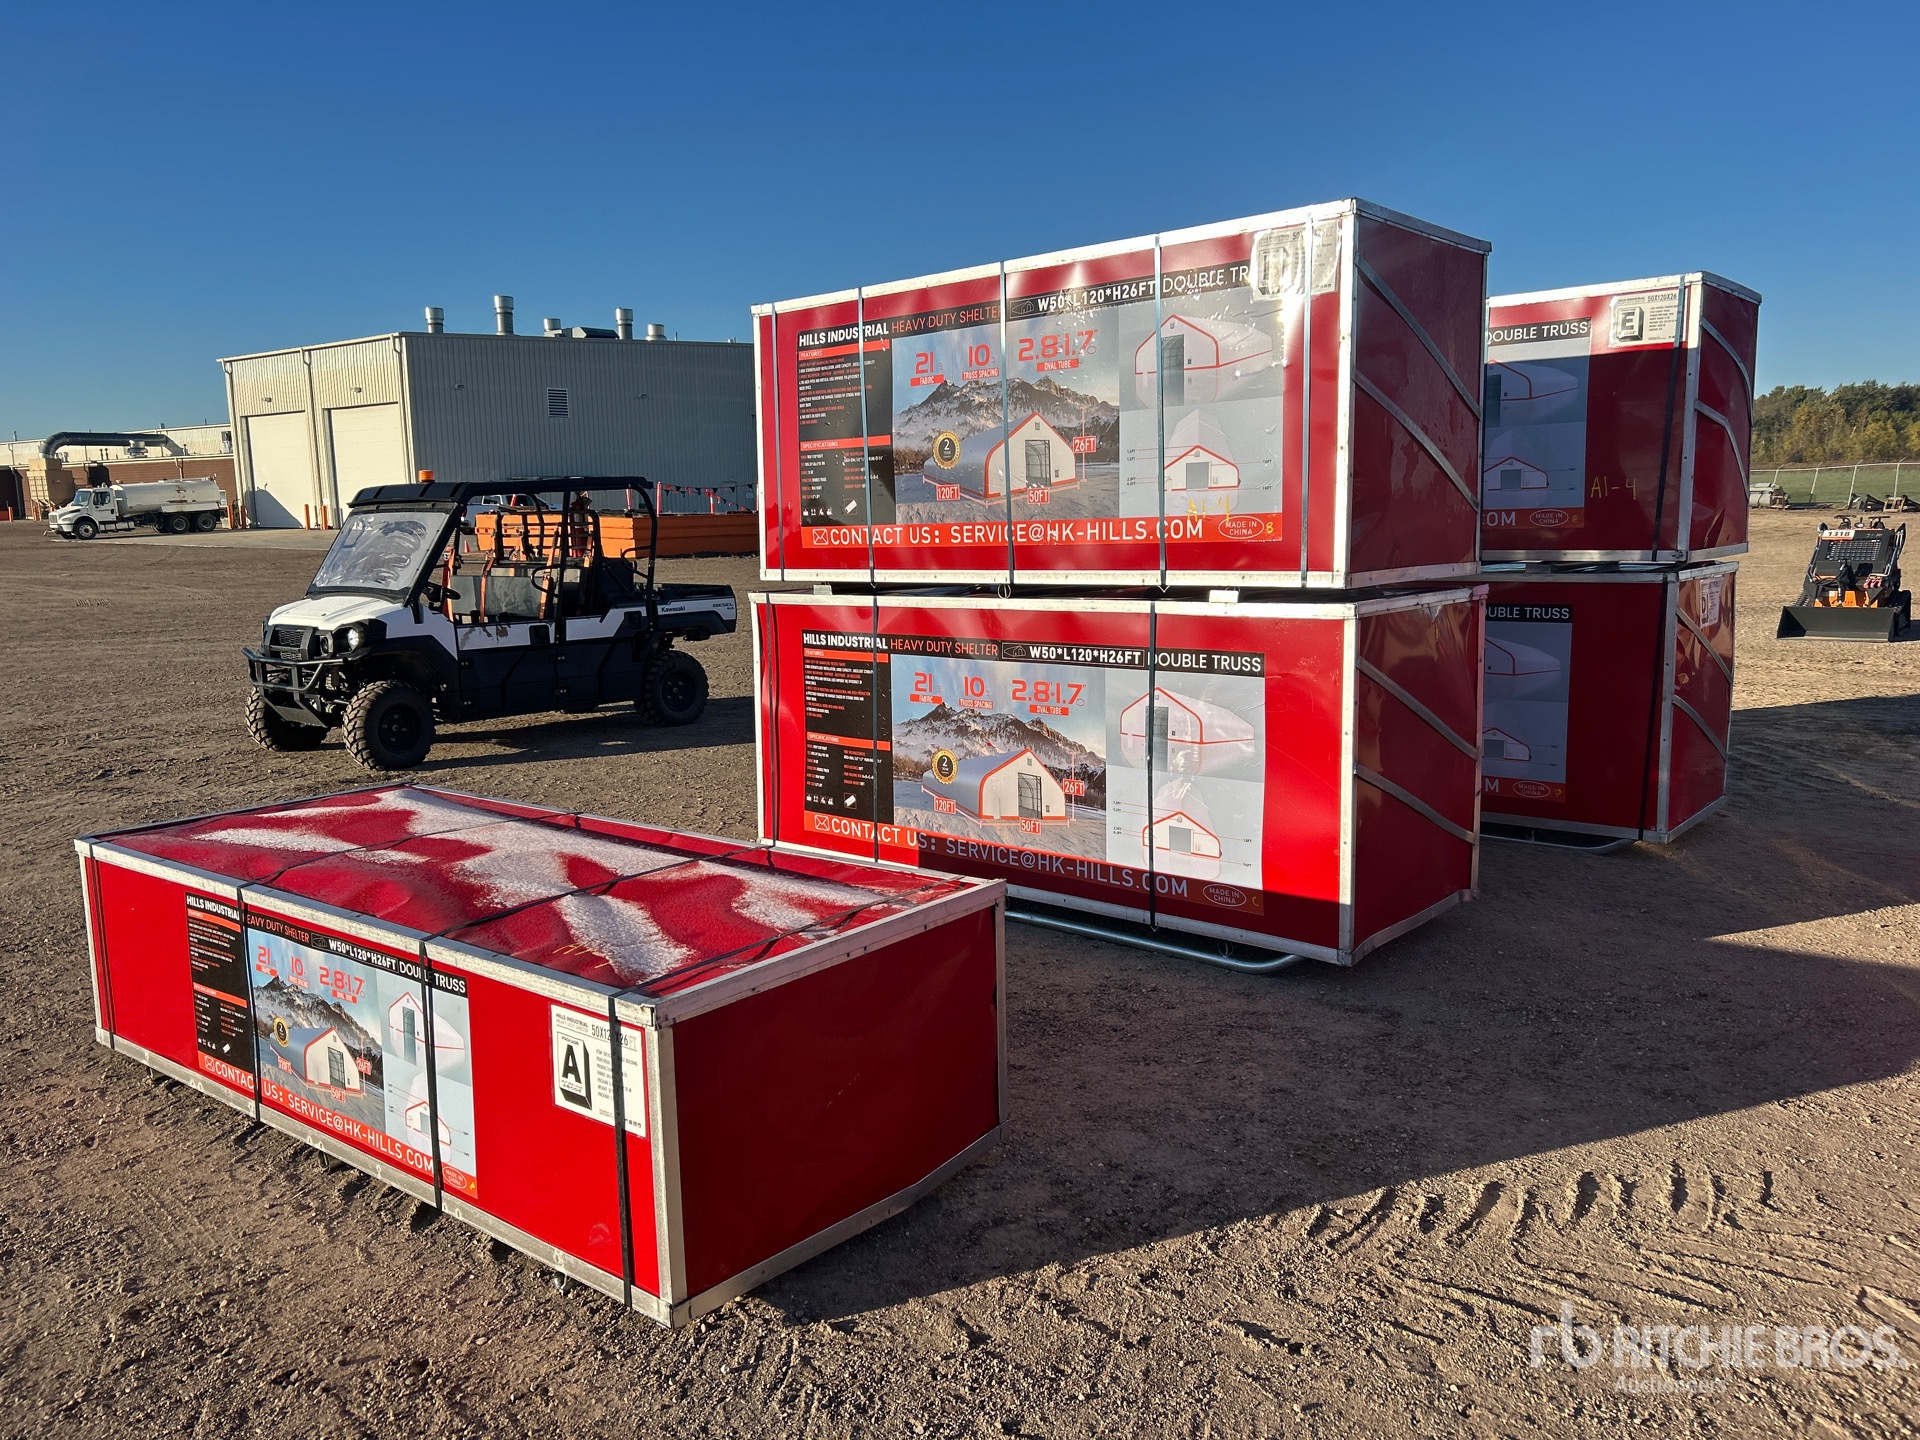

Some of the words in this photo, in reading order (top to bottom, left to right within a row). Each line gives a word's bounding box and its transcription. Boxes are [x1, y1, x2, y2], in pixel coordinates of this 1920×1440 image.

[799, 332, 826, 347] HILLS
[891, 317, 926, 334] HEAVY
[928, 314, 957, 330] DUTY
[1162, 269, 1225, 293] DOUBLE
[1621, 312, 1635, 330] E
[1541, 321, 1588, 338] TRUSS
[915, 352, 934, 374] 21
[968, 344, 990, 368] 10
[1044, 361, 1057, 370] OVAL
[1058, 360, 1072, 368] TUBE
[963, 371, 978, 380] TRUSS
[979, 368, 999, 377] SPACING
[943, 439, 950, 451] 2
[1074, 438, 1097, 453] 26FT
[938, 487, 959, 500] 120FT
[1029, 490, 1049, 503] 50FT
[830, 527, 903, 545] CONTACT
[1524, 607, 1570, 619] TRUSS
[803, 633, 827, 646] HILLS
[827, 635, 888, 649] INDUSTRIAL
[890, 639, 924, 651] HEAVY
[926, 641, 952, 654] DUTY
[954, 643, 998, 656] SHELTER
[1147, 652, 1208, 669] DOUBLE
[1212, 653, 1262, 672] TRUSS
[914, 672, 933, 693] 21
[964, 676, 985, 697] 10
[960, 699, 973, 707] TRUSS
[974, 701, 993, 710] SPACING
[1036, 704, 1048, 713] OVAL
[1049, 706, 1063, 715] TUBE
[942, 756, 949, 767] 2
[1064, 781, 1084, 794] 26FT
[935, 800, 956, 813] 120FT
[1021, 819, 1041, 833] 50FT
[831, 818, 900, 844] CONTACT
[946, 837, 1188, 898] SERVICE@HK-HILLS.COM
[1209, 887, 1230, 897] MADE
[1213, 894, 1237, 904] CHINA
[186, 895, 205, 909] HILLS
[266, 918, 284, 933] DUTY
[284, 926, 310, 943] SHELTER
[399, 961, 432, 983] DOULE
[433, 972, 466, 994] TRUSS
[257, 945, 271, 966] 21
[291, 955, 304, 977] 10
[566, 1016, 588, 1028] INDUSTRIAL
[591, 1024, 629, 1047] 50X12X26
[562, 1044, 582, 1084] A
[331, 1088, 345, 1101] 50FT
[215, 1061, 254, 1089] CONTAC
[287, 1093, 434, 1175] SERVICE@HK-HILLS.COM
